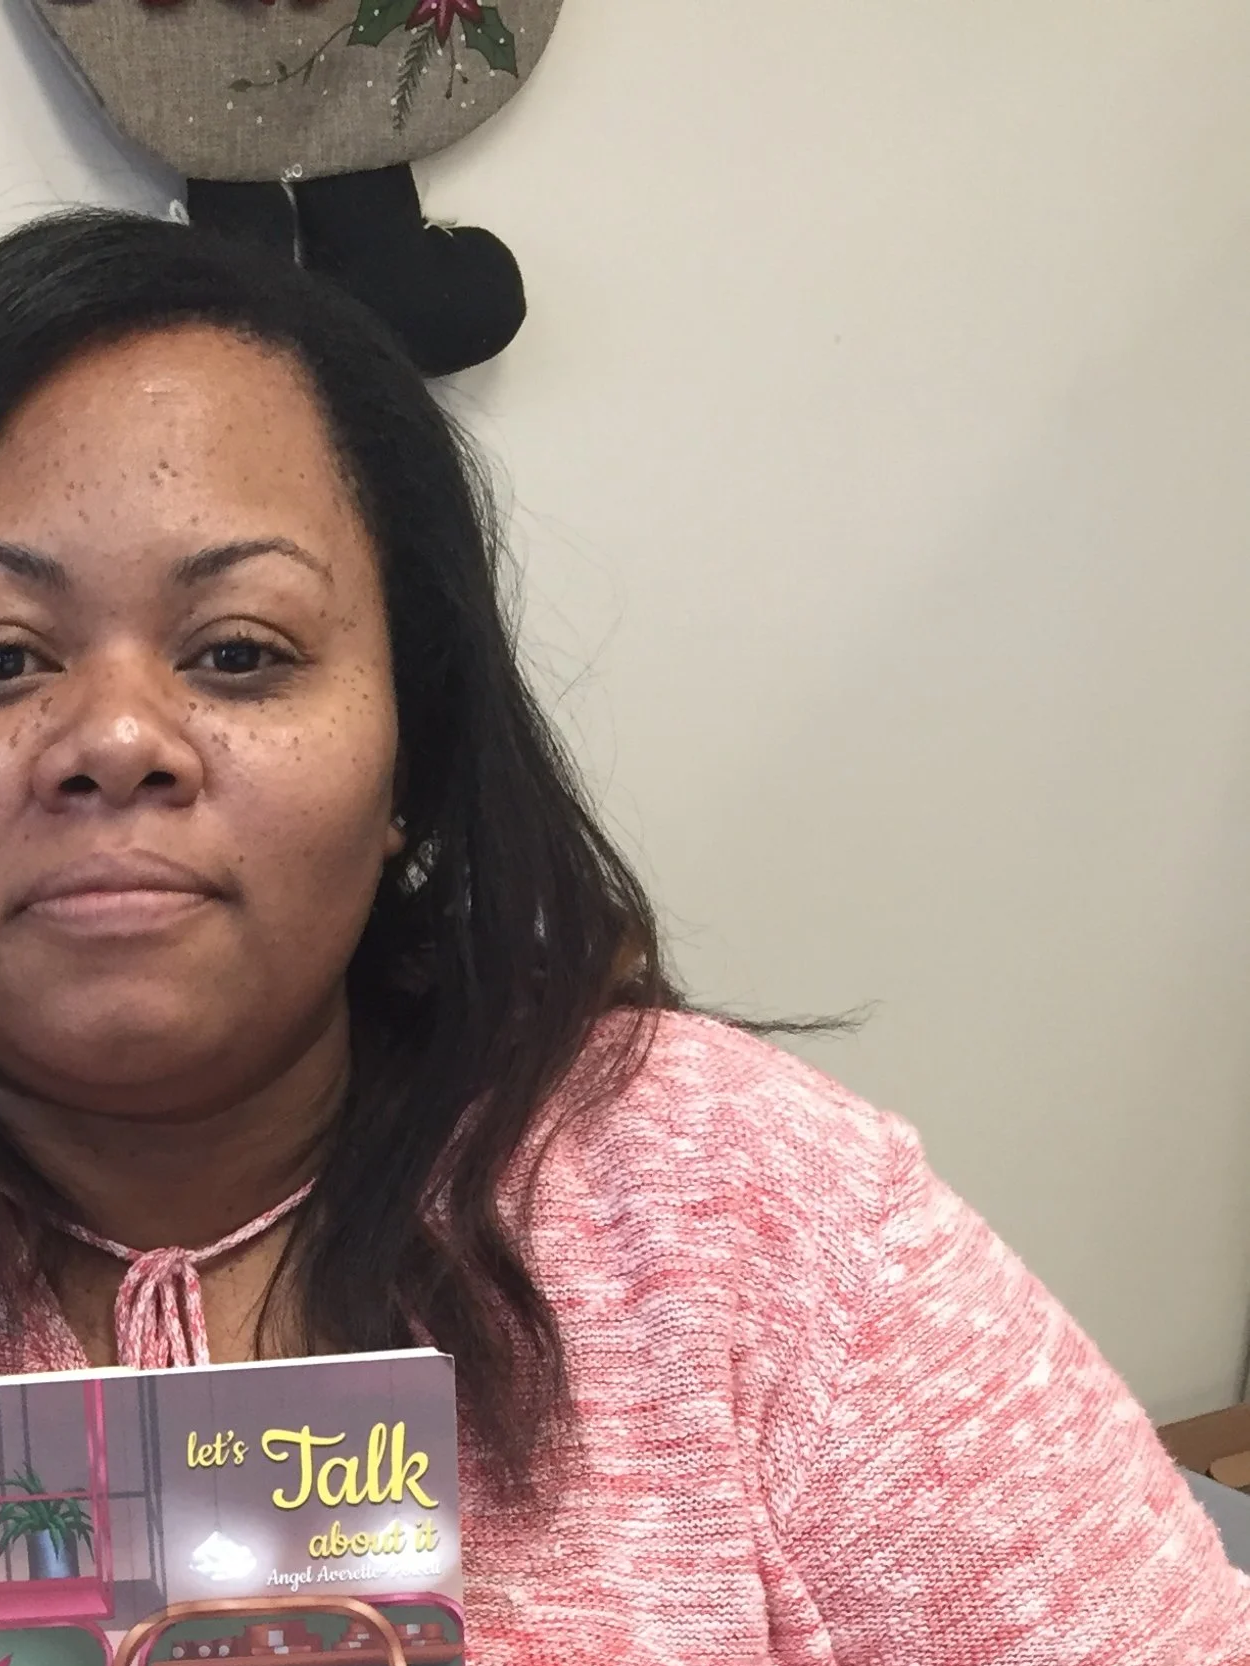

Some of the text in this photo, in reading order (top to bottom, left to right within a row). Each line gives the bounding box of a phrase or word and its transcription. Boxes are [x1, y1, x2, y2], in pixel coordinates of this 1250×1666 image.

[187, 1422, 439, 1509] let's Talk
[309, 1518, 439, 1558] about it
[267, 1566, 312, 1592] Angel
